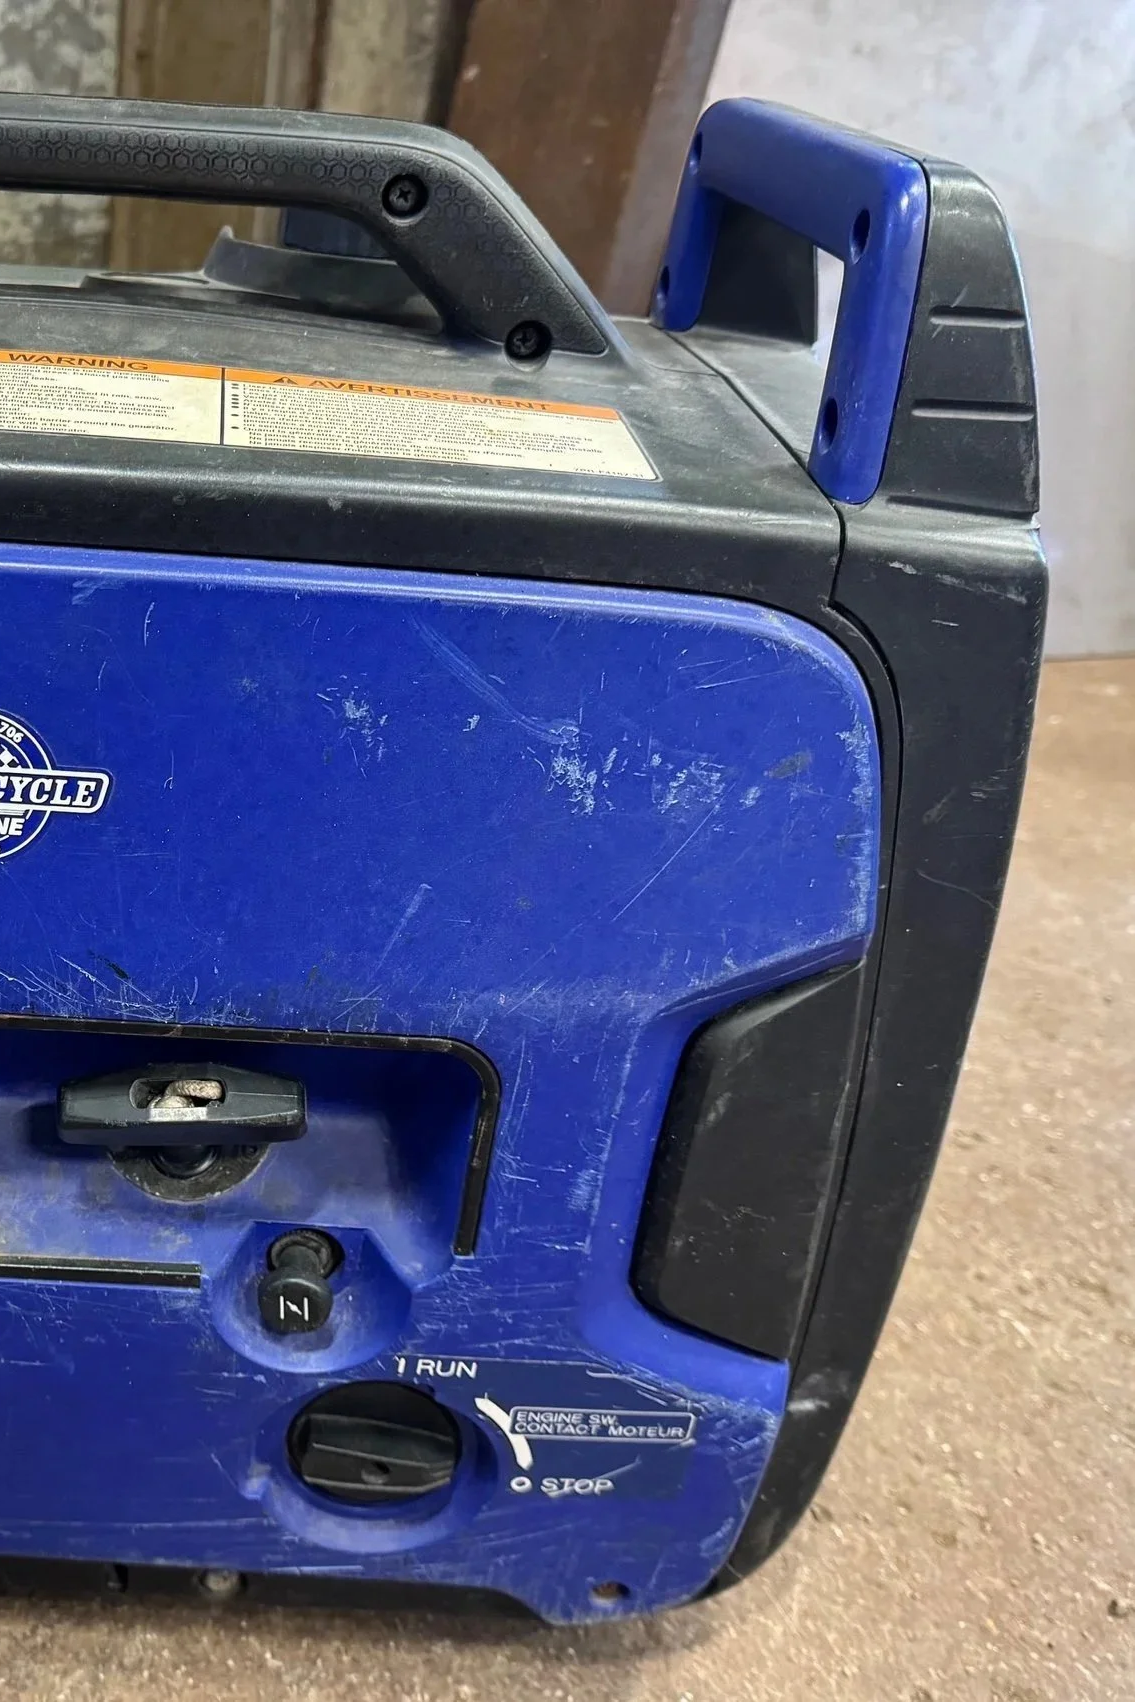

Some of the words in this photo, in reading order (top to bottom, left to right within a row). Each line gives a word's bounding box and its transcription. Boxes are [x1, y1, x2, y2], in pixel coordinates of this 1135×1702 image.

[8, 354, 149, 370] WARNING
[309, 380, 552, 411] AVERTISSEMENT
[416, 1358, 478, 1379] RUN
[516, 1411, 584, 1424] ENGINE
[588, 1413, 619, 1426] SW.
[515, 1422, 601, 1435] CONTACT
[607, 1425, 686, 1438] MOTEUR
[540, 1477, 615, 1496] STOP
